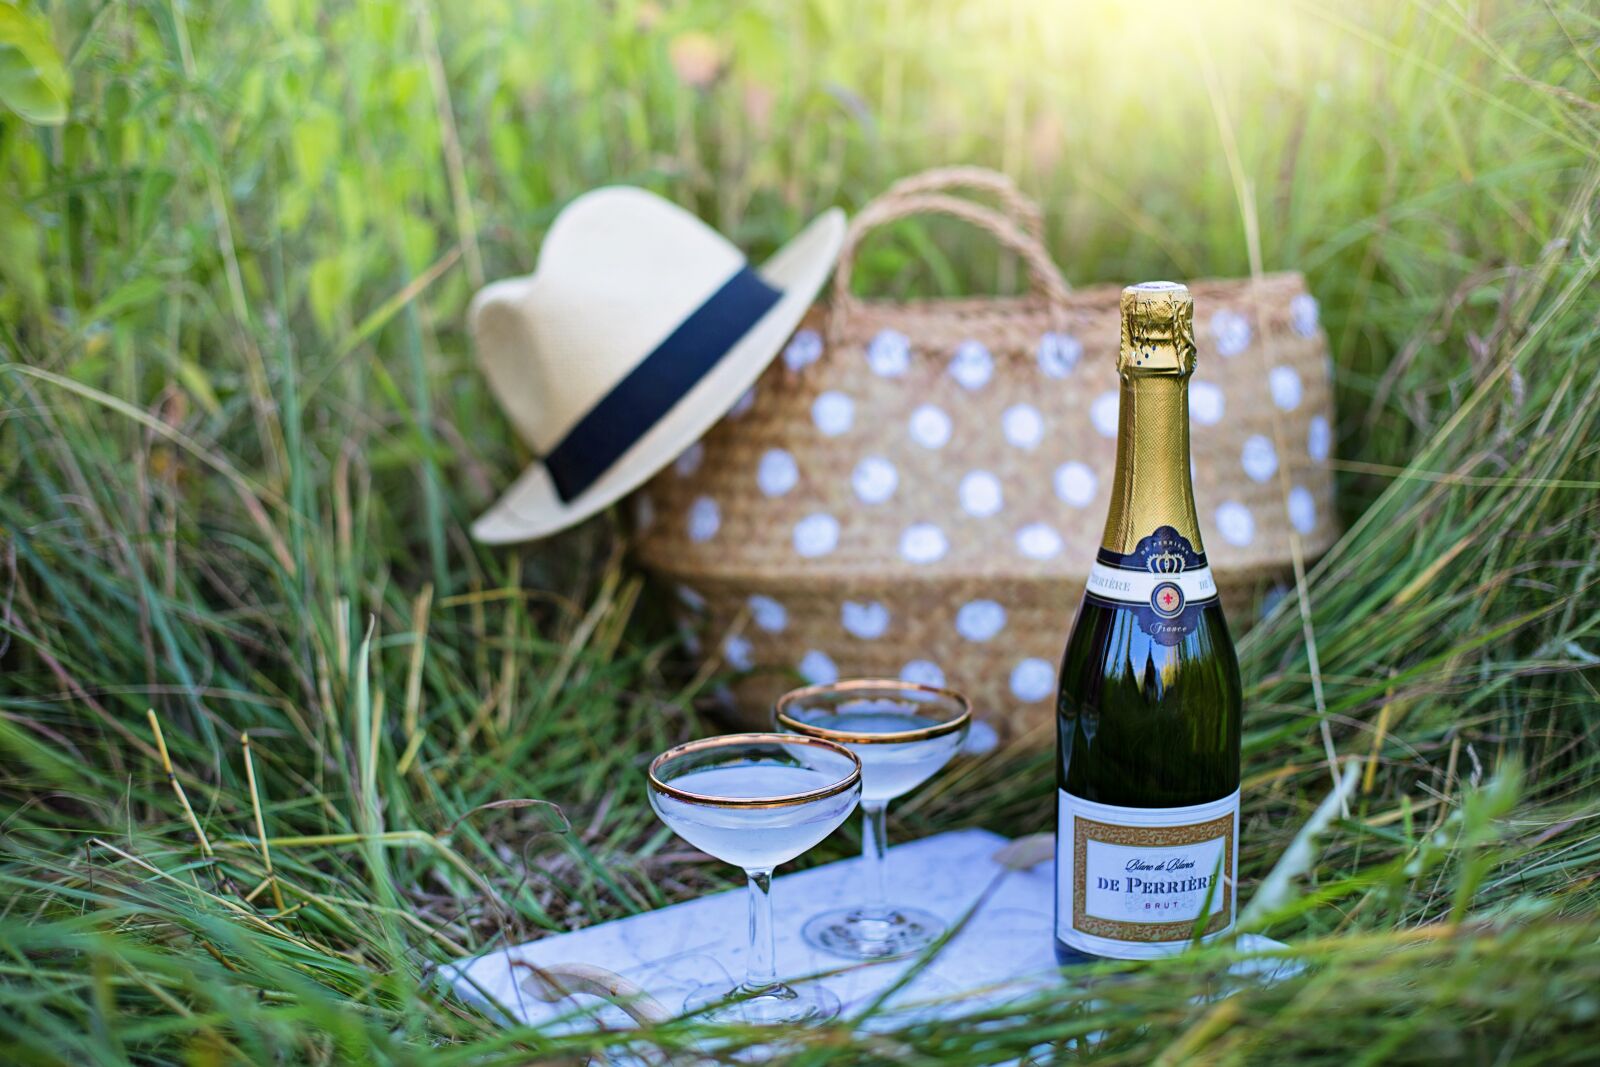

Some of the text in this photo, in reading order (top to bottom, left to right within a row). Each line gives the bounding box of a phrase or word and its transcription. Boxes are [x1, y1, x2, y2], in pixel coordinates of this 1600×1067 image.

[1150, 622, 1187, 635] France
[1125, 857, 1196, 873] Blanc de Blancs
[1098, 876, 1120, 892] DE
[1145, 901, 1178, 909] BRUT
